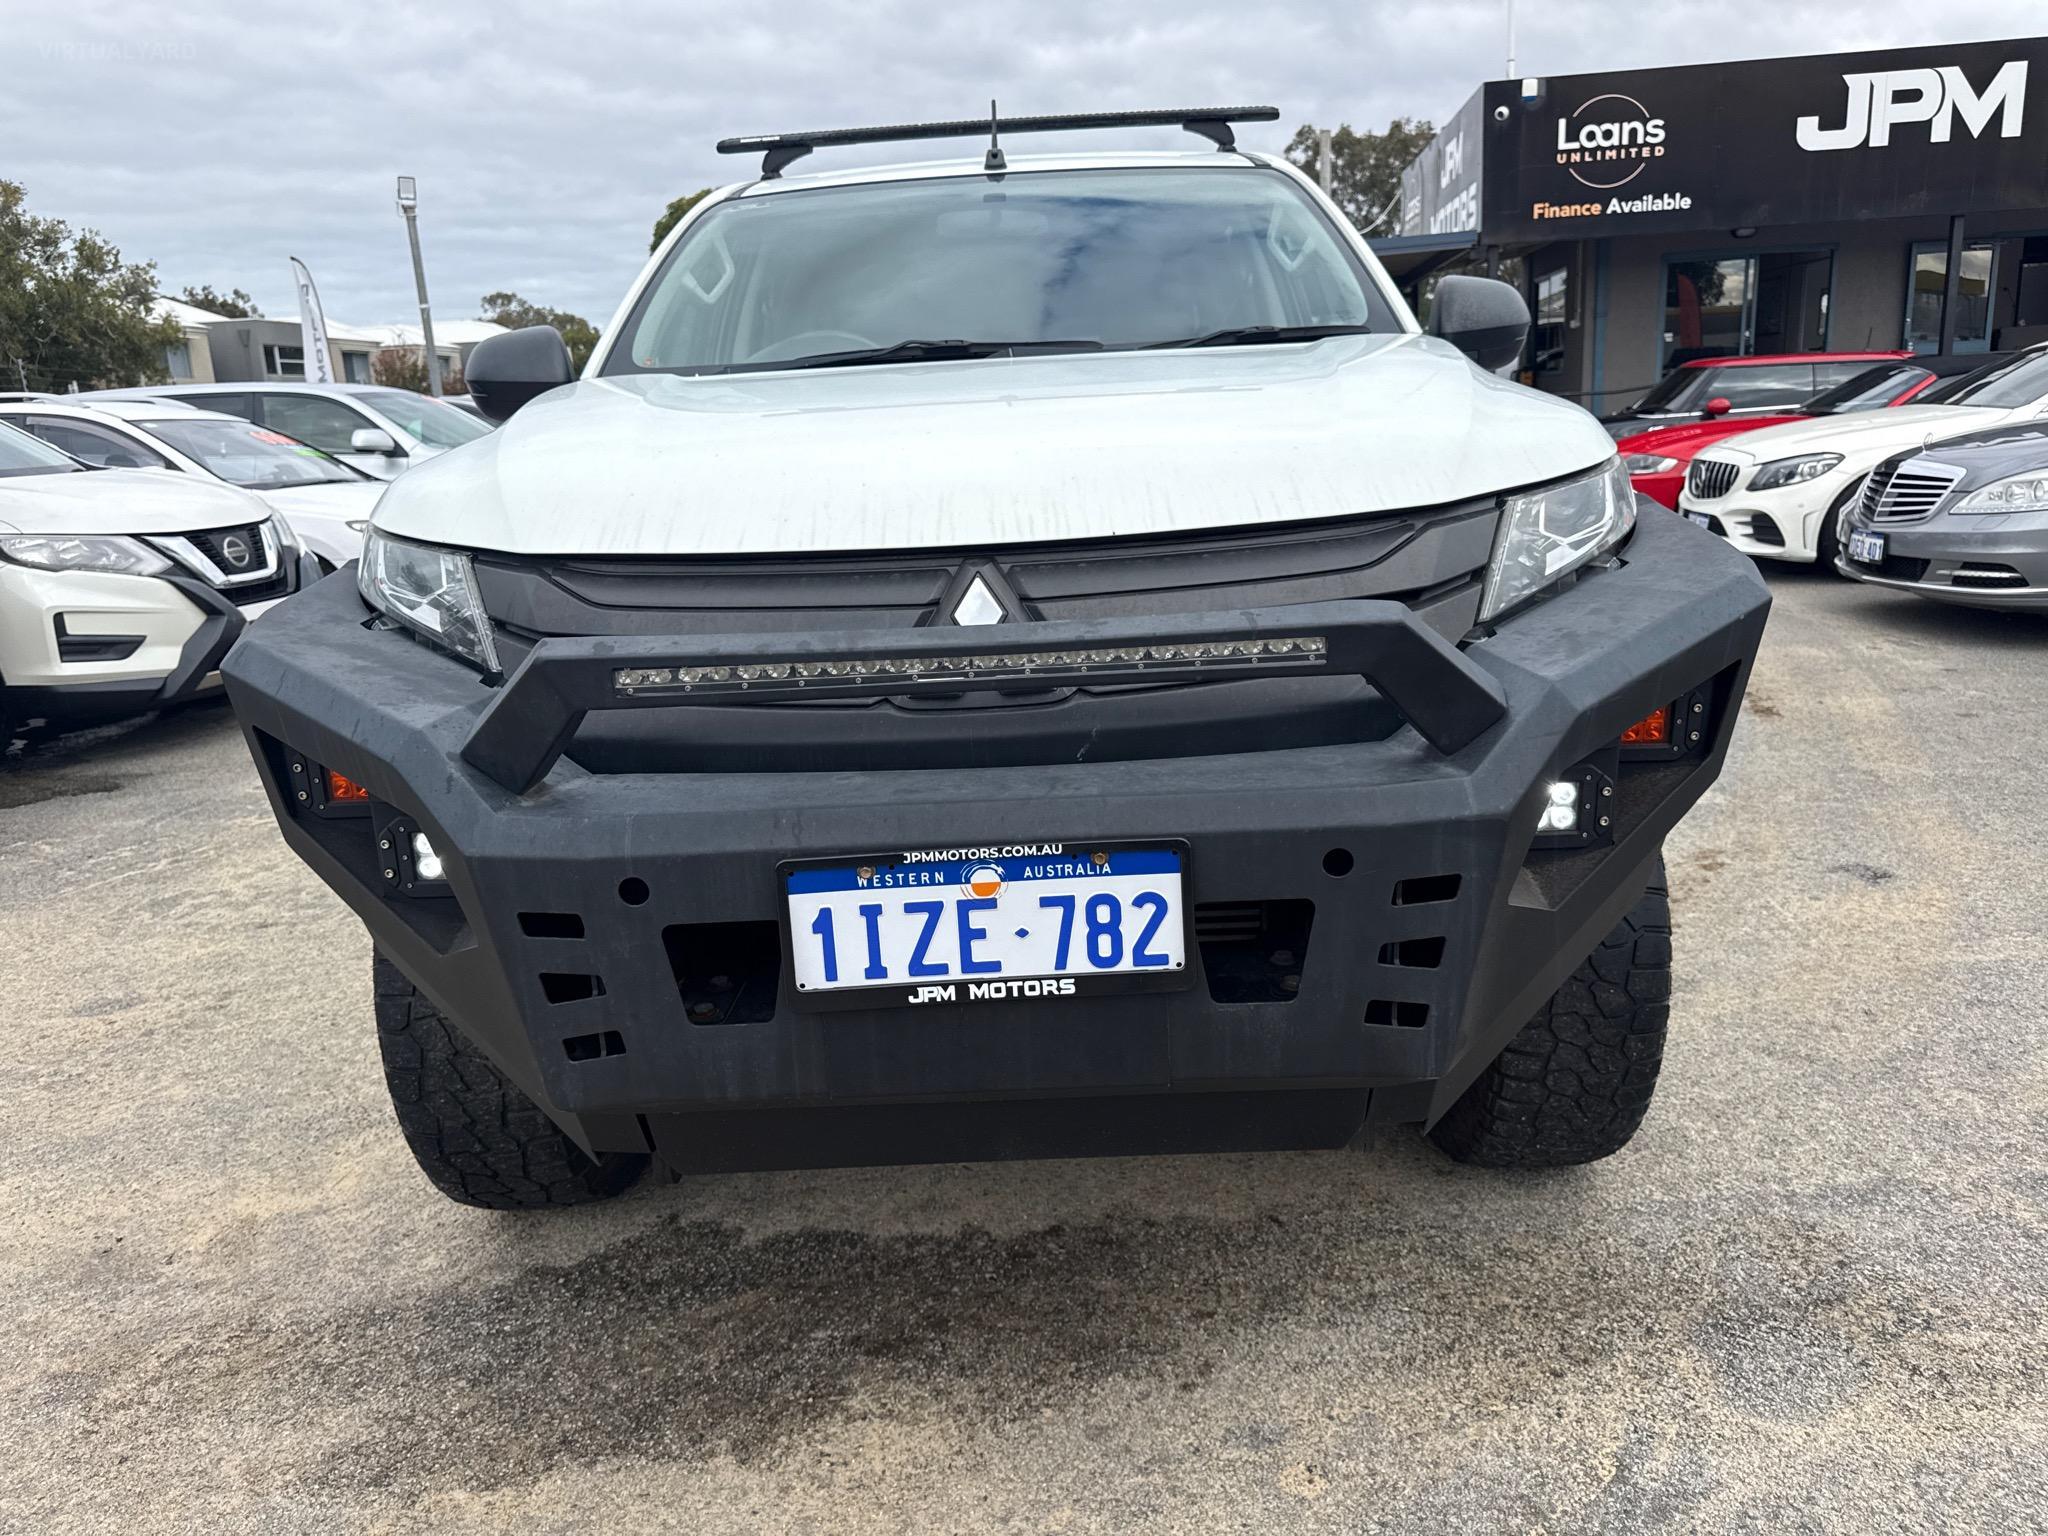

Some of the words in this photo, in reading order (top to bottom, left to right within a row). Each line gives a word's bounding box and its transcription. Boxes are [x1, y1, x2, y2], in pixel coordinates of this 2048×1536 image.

[1796, 60, 2029, 151] JPM
[1557, 117, 1666, 150] Loans
[1556, 146, 1665, 164] UNLIMITED
[1532, 202, 1603, 219] Finance
[1606, 192, 1692, 215] Available
[903, 843, 1063, 864] JPMMOTORS.COM.AU
[857, 871, 945, 888] WESTERN
[1023, 862, 1112, 879] AUSTRALIA
[908, 985, 956, 1004] JPM
[969, 978, 1076, 999] MOTORS
